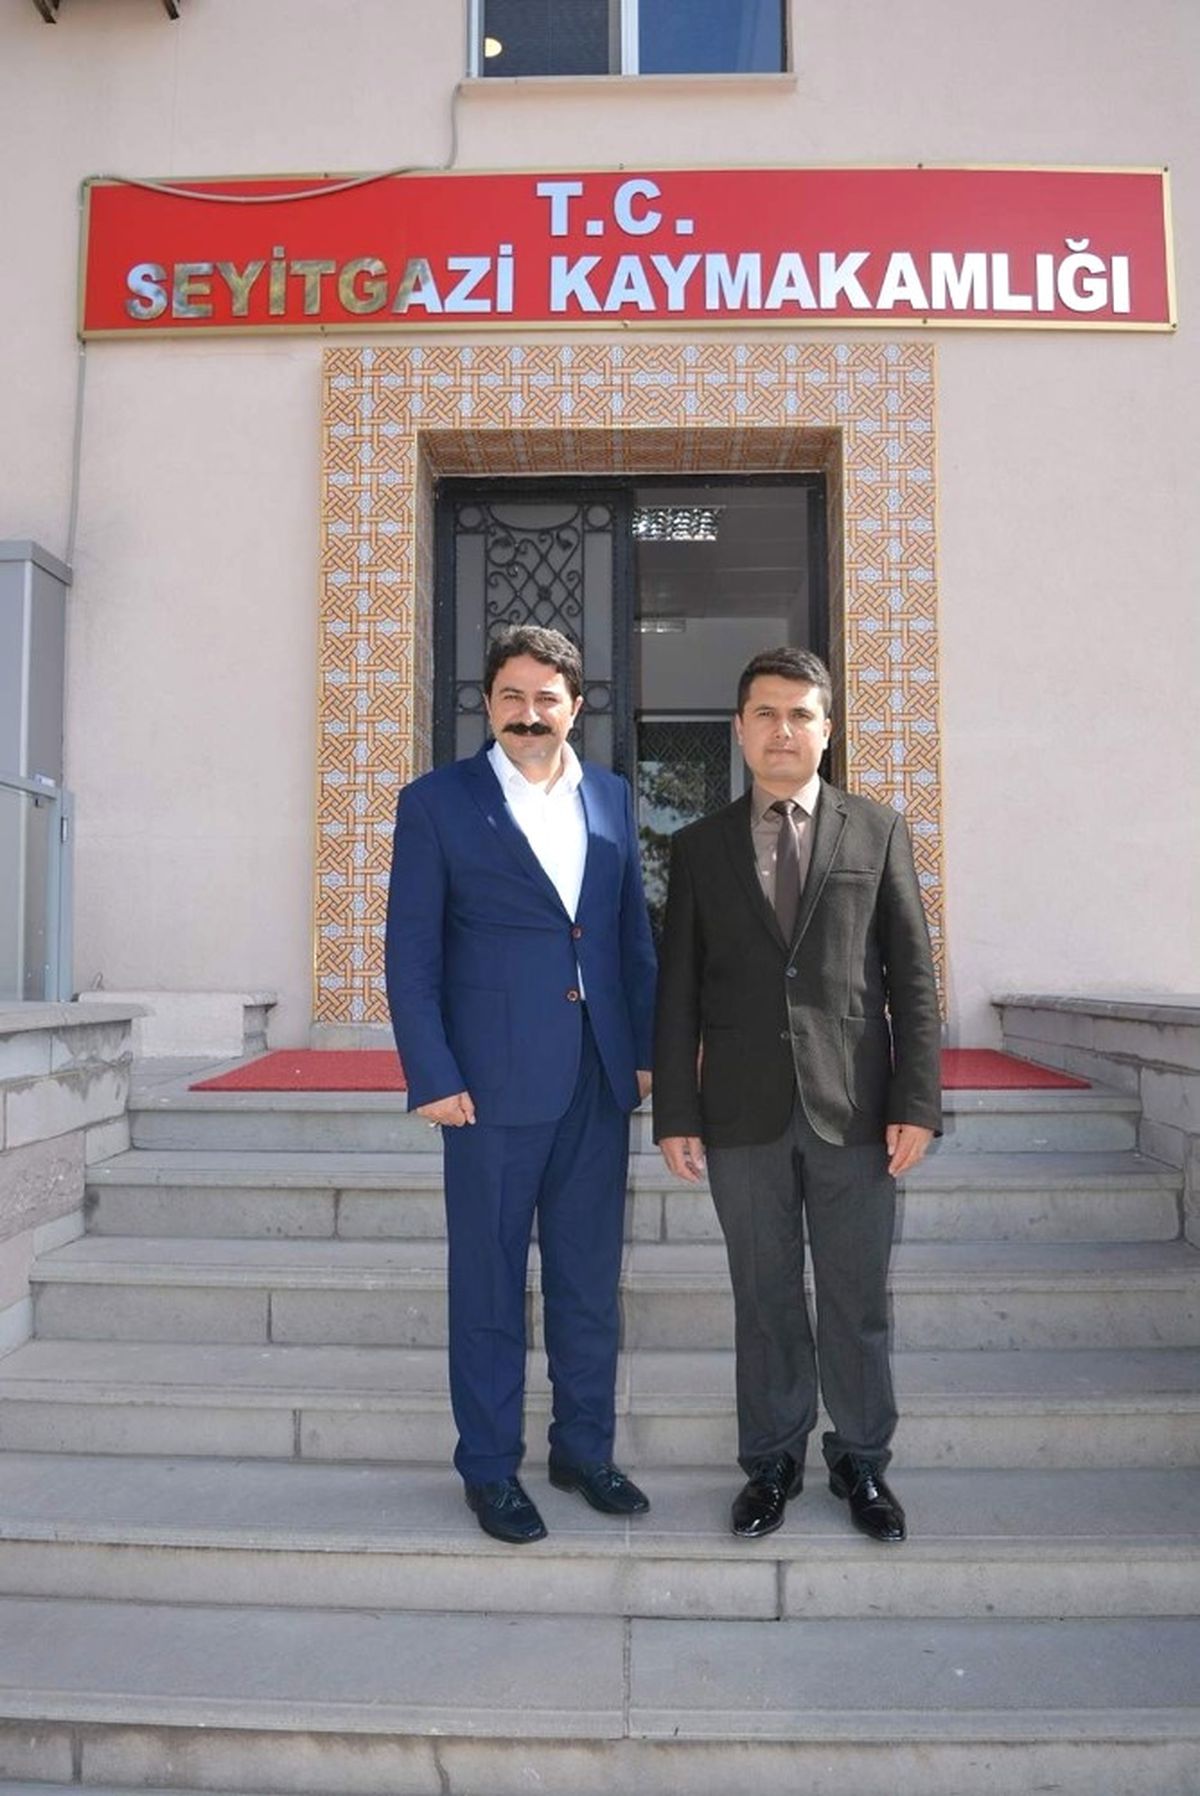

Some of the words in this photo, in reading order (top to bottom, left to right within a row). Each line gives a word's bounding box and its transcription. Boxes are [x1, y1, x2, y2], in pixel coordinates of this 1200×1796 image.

[536, 179, 695, 237] T.C.
[125, 244, 514, 321] SEYİTGAZİ
[549, 238, 1131, 314] KAYMAKAMLIĞI
